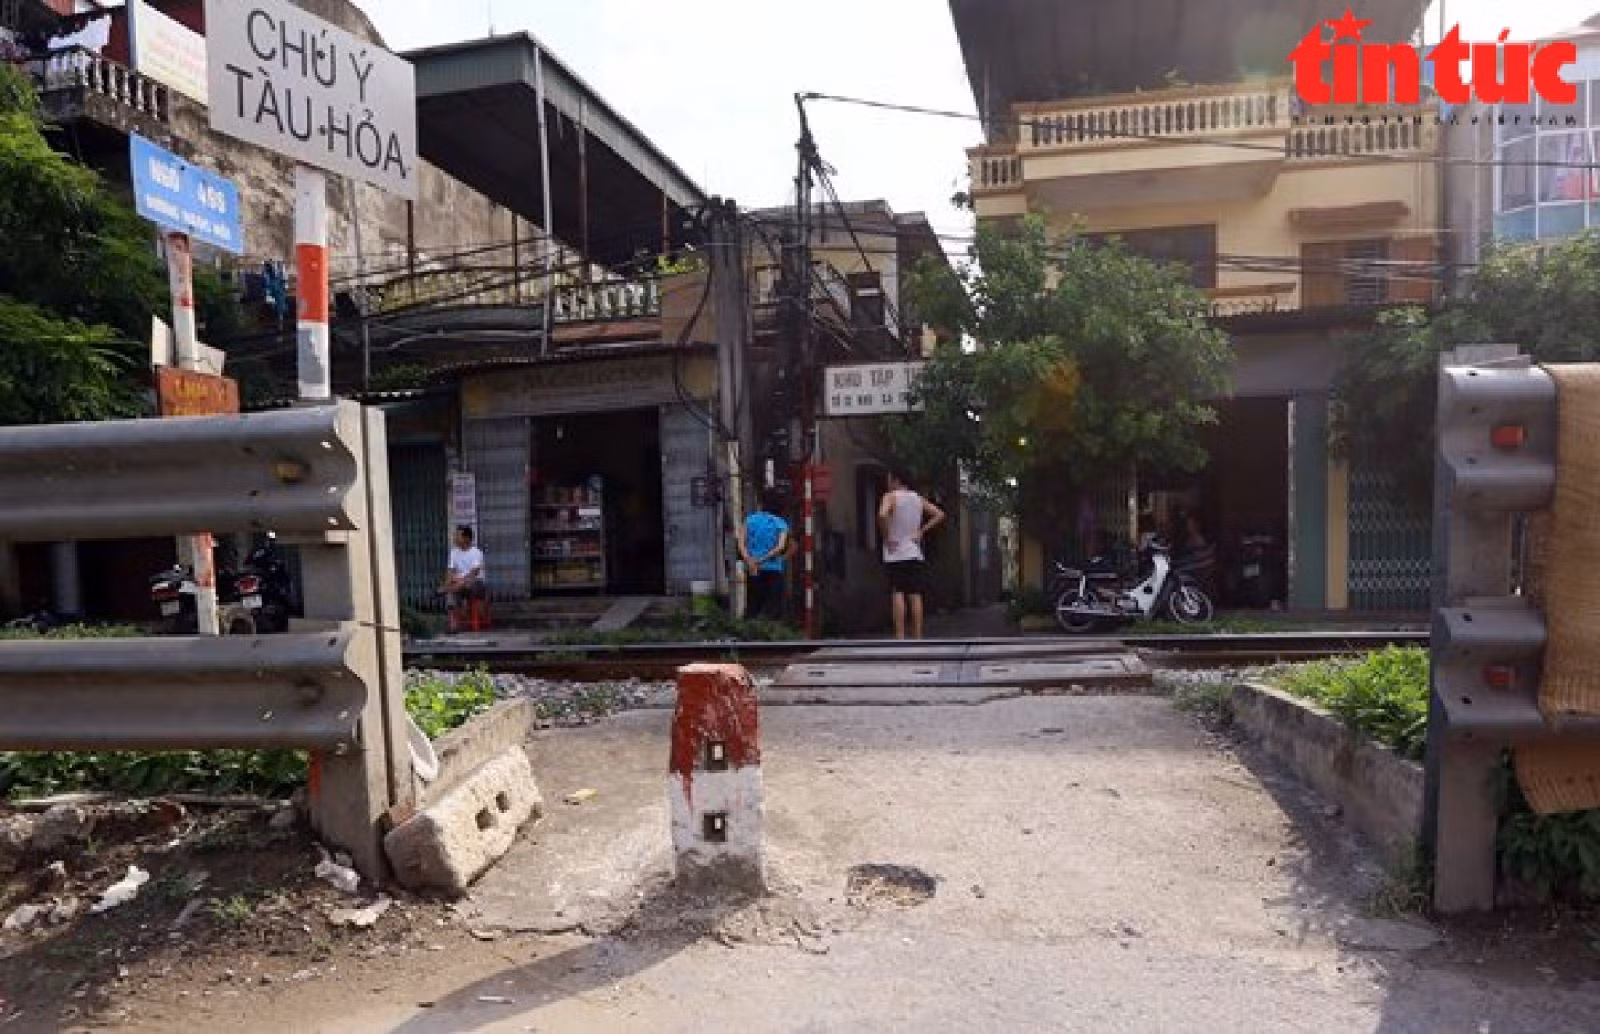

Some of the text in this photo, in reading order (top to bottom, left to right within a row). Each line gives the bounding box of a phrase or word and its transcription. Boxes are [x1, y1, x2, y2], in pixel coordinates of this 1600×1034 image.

[248, 8, 337, 88] CHÚ
[349, 48, 374, 102] Ý
[225, 63, 407, 180] TÀU HỎA
